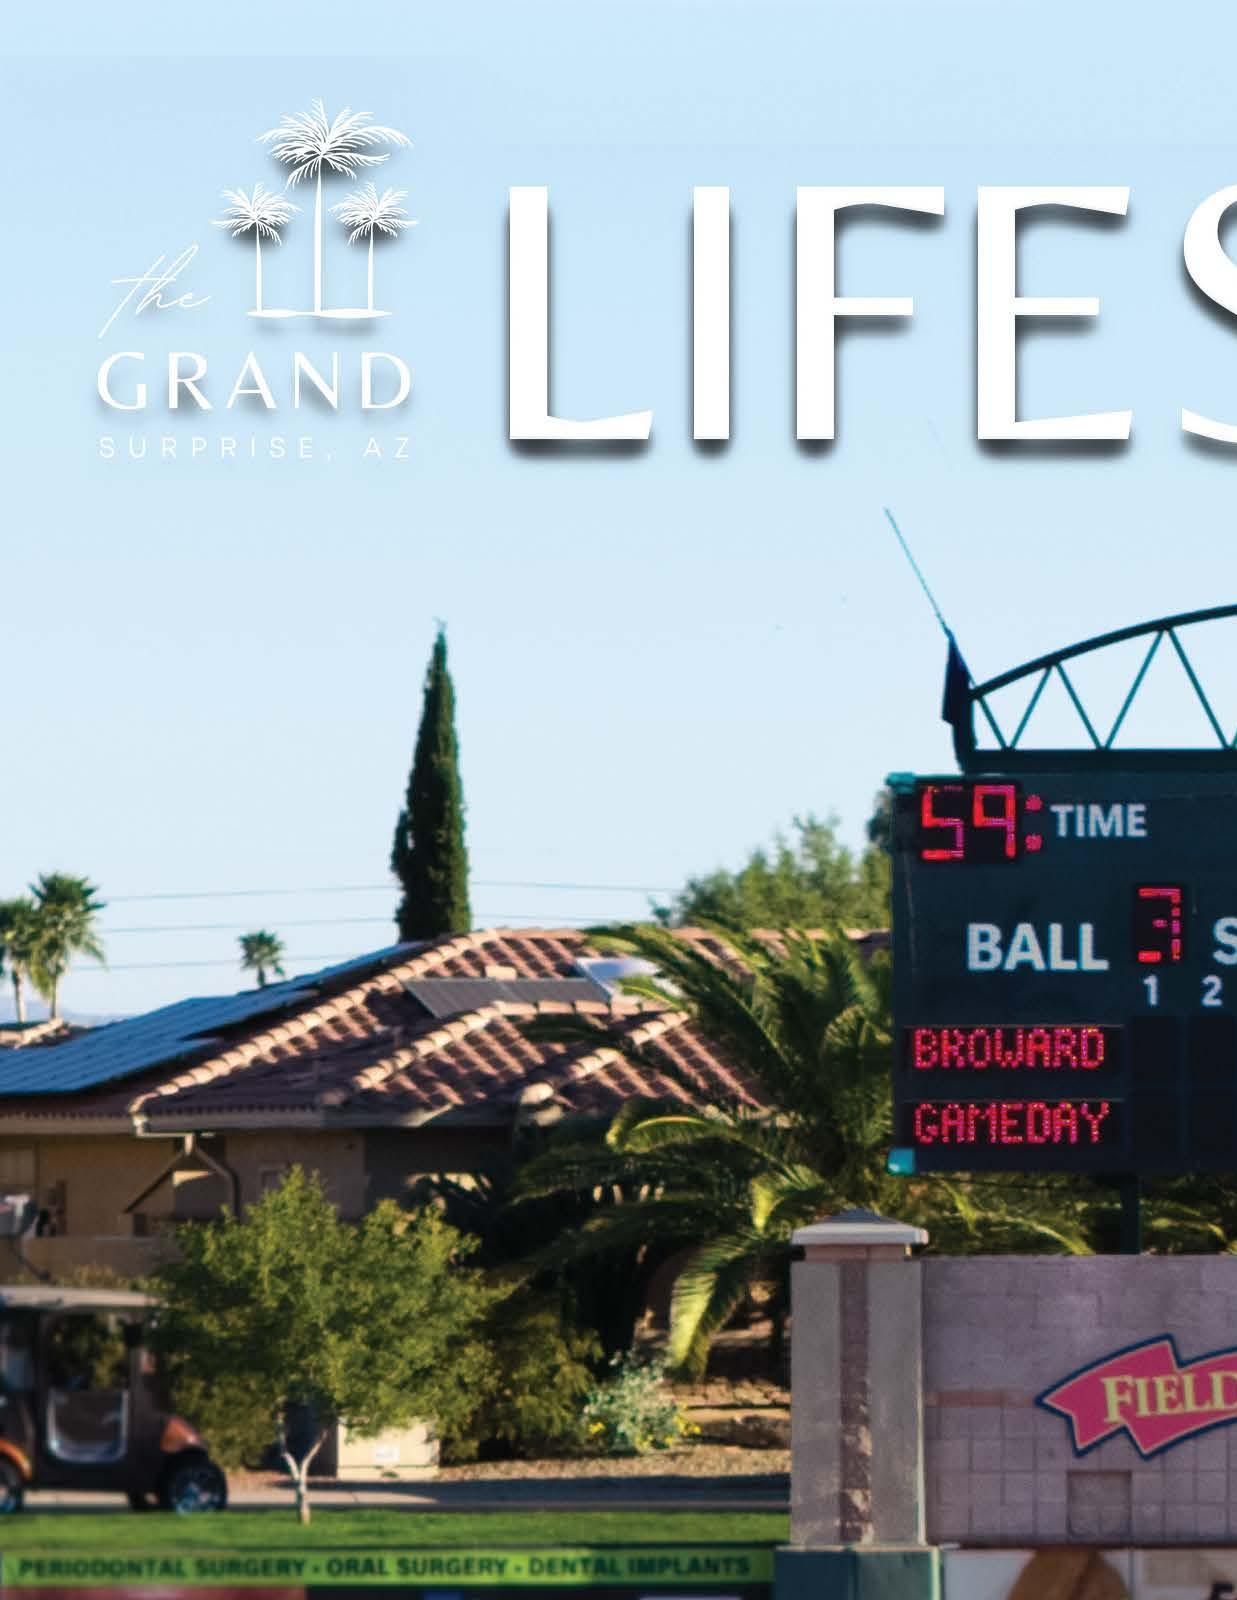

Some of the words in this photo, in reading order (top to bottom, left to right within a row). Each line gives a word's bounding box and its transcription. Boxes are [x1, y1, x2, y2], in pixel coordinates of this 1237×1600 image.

[1051, 804, 1148, 838] TIME
[968, 923, 1110, 971] BALL
[1144, 975, 1158, 1006] 1
[1202, 975, 1222, 1006] 2
[914, 1027, 1105, 1069] BROWARD
[914, 1102, 1109, 1144] GAMEDAY
[18, 1557, 188, 1578] PERIODONTAL
[195, 1557, 305, 1578] SURGERY
[326, 1556, 390, 1577] ORAL
[399, 1556, 509, 1577] SURGERY
[529, 1555, 622, 1576] DENTAL
[628, 1555, 750, 1576] IMPLANTS
